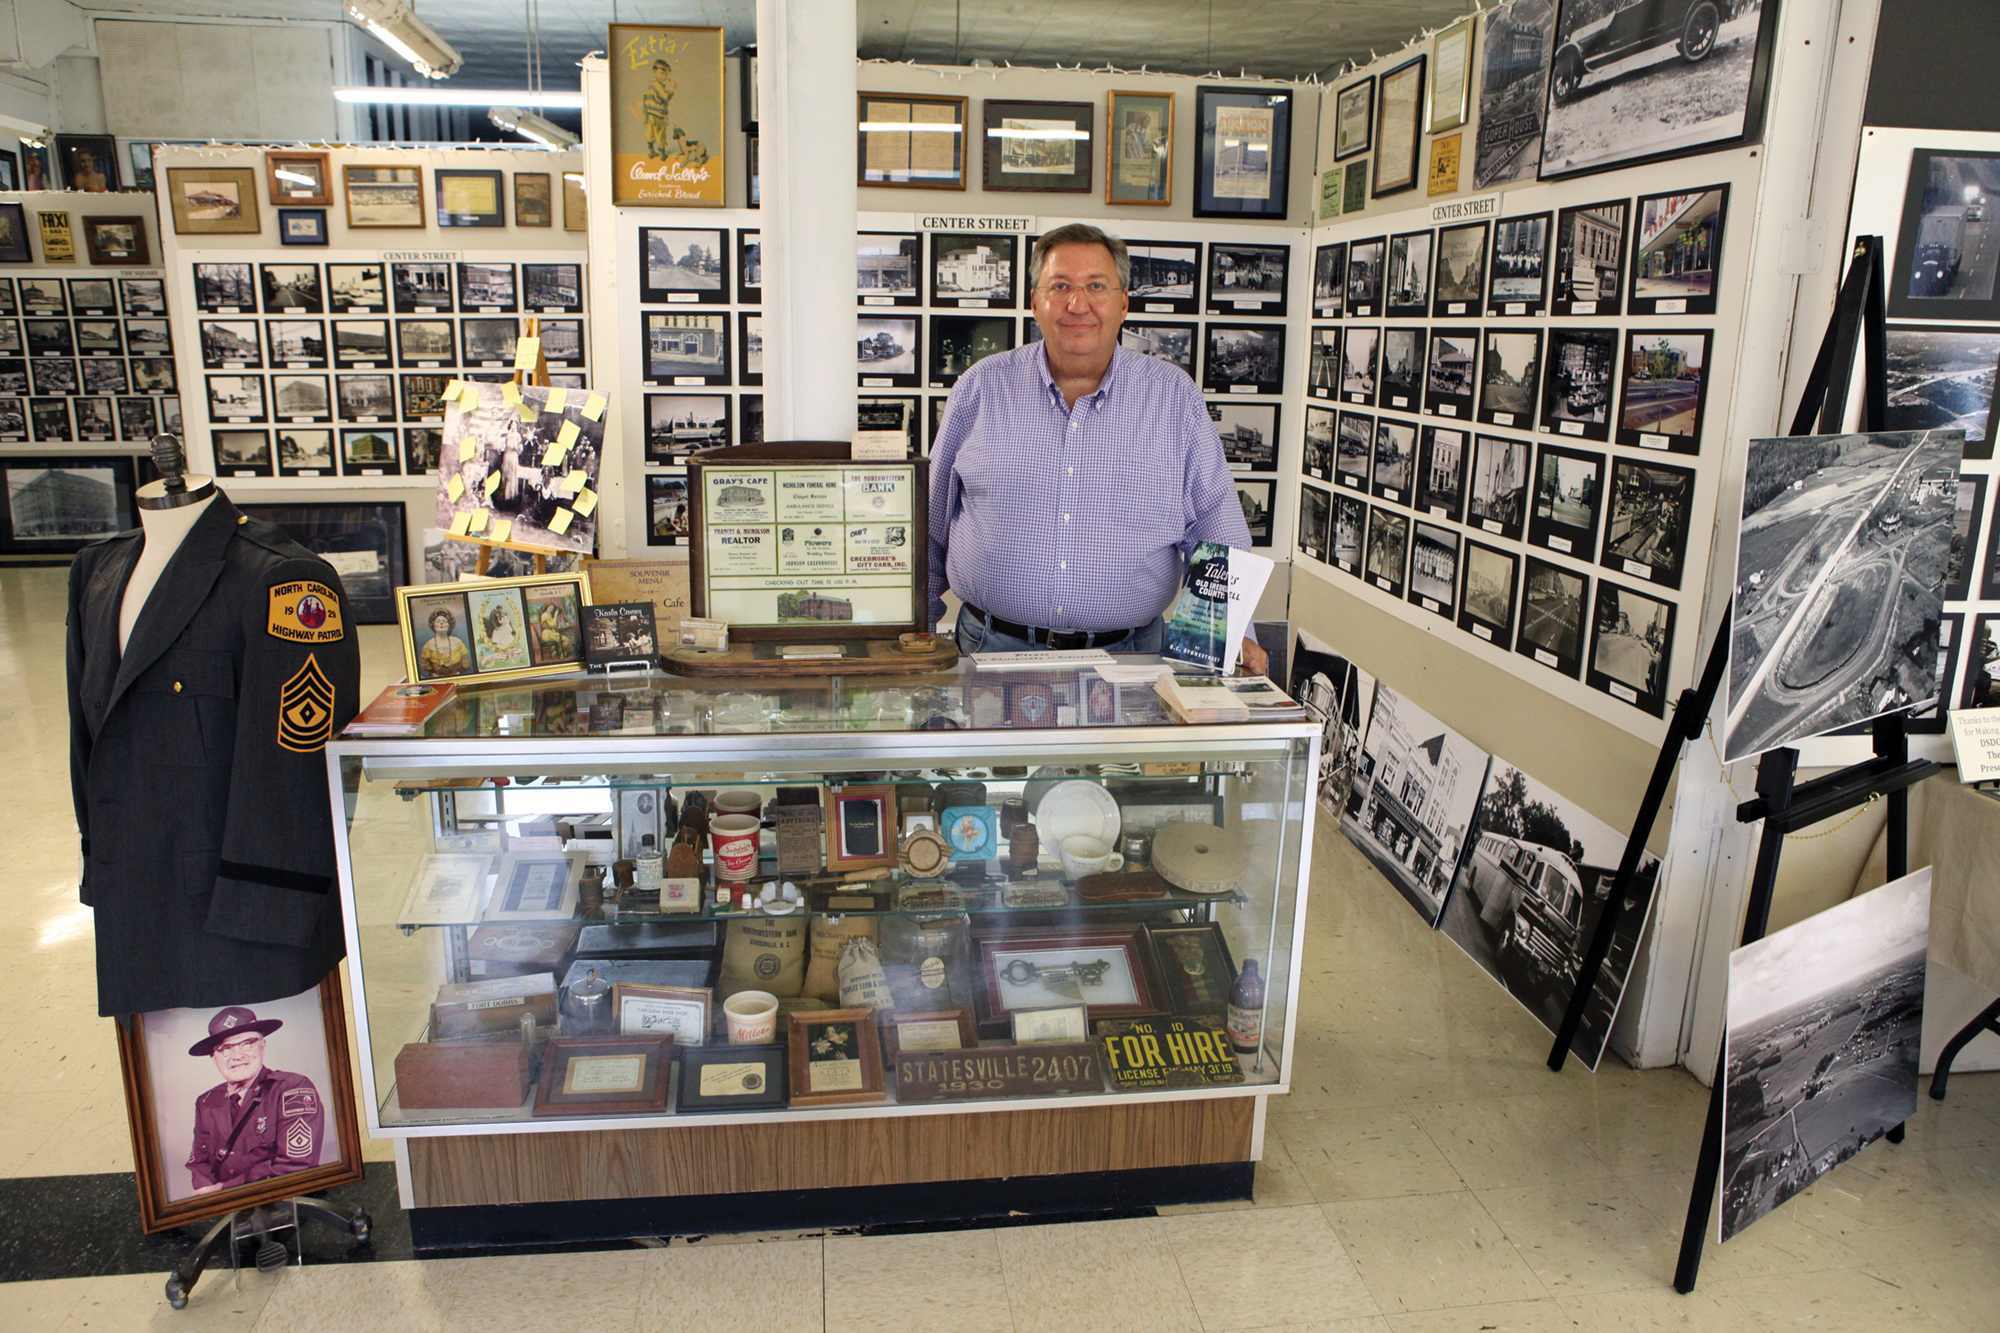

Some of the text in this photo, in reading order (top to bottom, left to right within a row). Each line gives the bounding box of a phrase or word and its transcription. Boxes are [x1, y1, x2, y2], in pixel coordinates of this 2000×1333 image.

[1219, 118, 1268, 132] AUCTION
[630, 161, 711, 184] Aunt Sally's
[638, 187, 702, 199] Enriched Bread
[1432, 198, 1496, 220] CENTER STREET
[40, 213, 69, 228] TAXI
[922, 217, 1030, 230] CENTER STREET
[383, 252, 458, 261] CENTER STREET
[713, 477, 768, 486] GRAY'S CAFE
[863, 484, 894, 492] BANK
[850, 528, 868, 537] CAB?
[1195, 579, 1209, 588] OLD
[274, 583, 338, 604] NORTH CAROLINA
[663, 597, 685, 608] Cafe
[284, 606, 294, 615] 19
[327, 609, 337, 619] 29
[594, 608, 619, 617] Karla
[272, 623, 343, 641] HIGHWAY PATROL
[1183, 649, 1221, 663] STONESTREET
[1957, 717, 1982, 725] Thanks
[1964, 728, 1974, 736] for
[742, 926, 798, 938] NORTHWESTERN BANK
[815, 931, 846, 939] MERCHANTS
[850, 974, 871, 983] DEPOSIT
[860, 981, 873, 990] LOAN
[863, 990, 877, 999] BANK
[472, 999, 519, 1009] FORT DOBBS
[1239, 1012, 1260, 1020] SOUTH
[1135, 1024, 1157, 1033] NO.
[1105, 1030, 1237, 1069] FOR HIRE
[903, 1055, 1092, 1083] STATESVILLE 2407
[1117, 1068, 1161, 1080] LICENSE
[938, 1079, 1004, 1092] 1930
